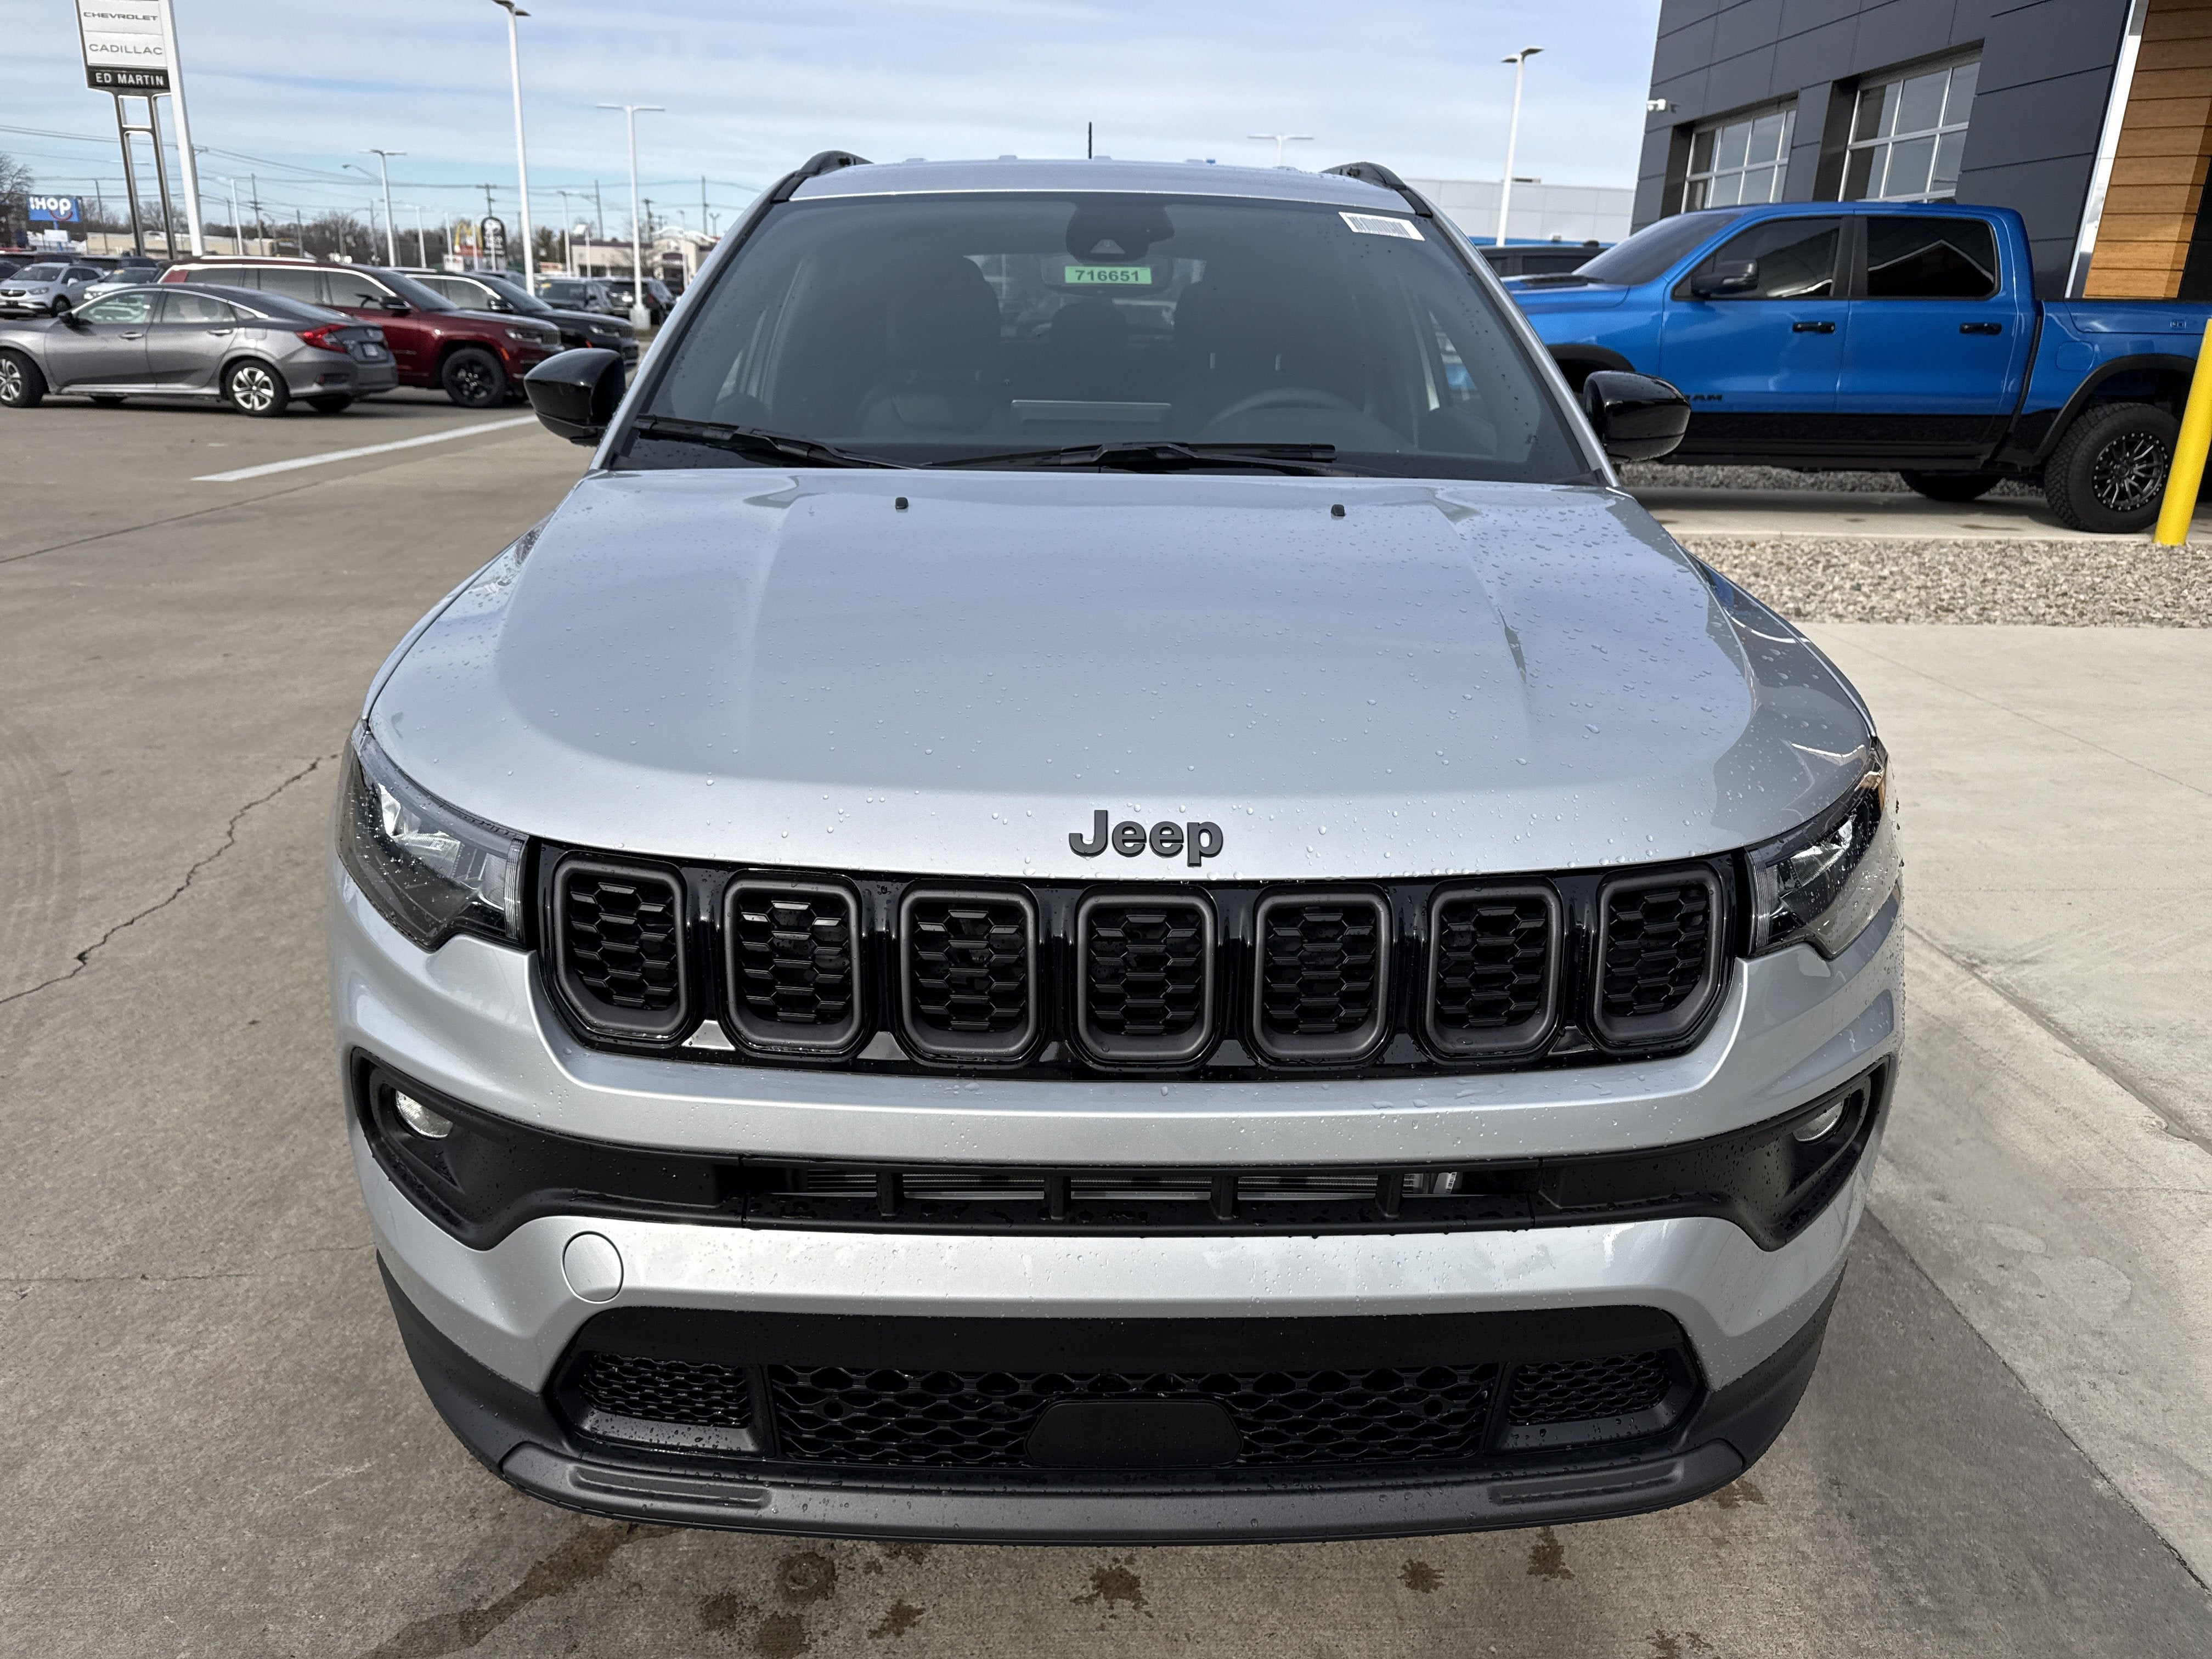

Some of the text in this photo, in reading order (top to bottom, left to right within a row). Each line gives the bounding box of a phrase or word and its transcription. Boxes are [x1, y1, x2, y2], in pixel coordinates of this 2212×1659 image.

[83, 12, 158, 21] CHEVROLET
[89, 43, 162, 55] CADILLAC
[95, 72, 163, 86] ED MARTIN
[1075, 270, 1139, 281] 716651
[1069, 810, 1223, 867] Jeep
